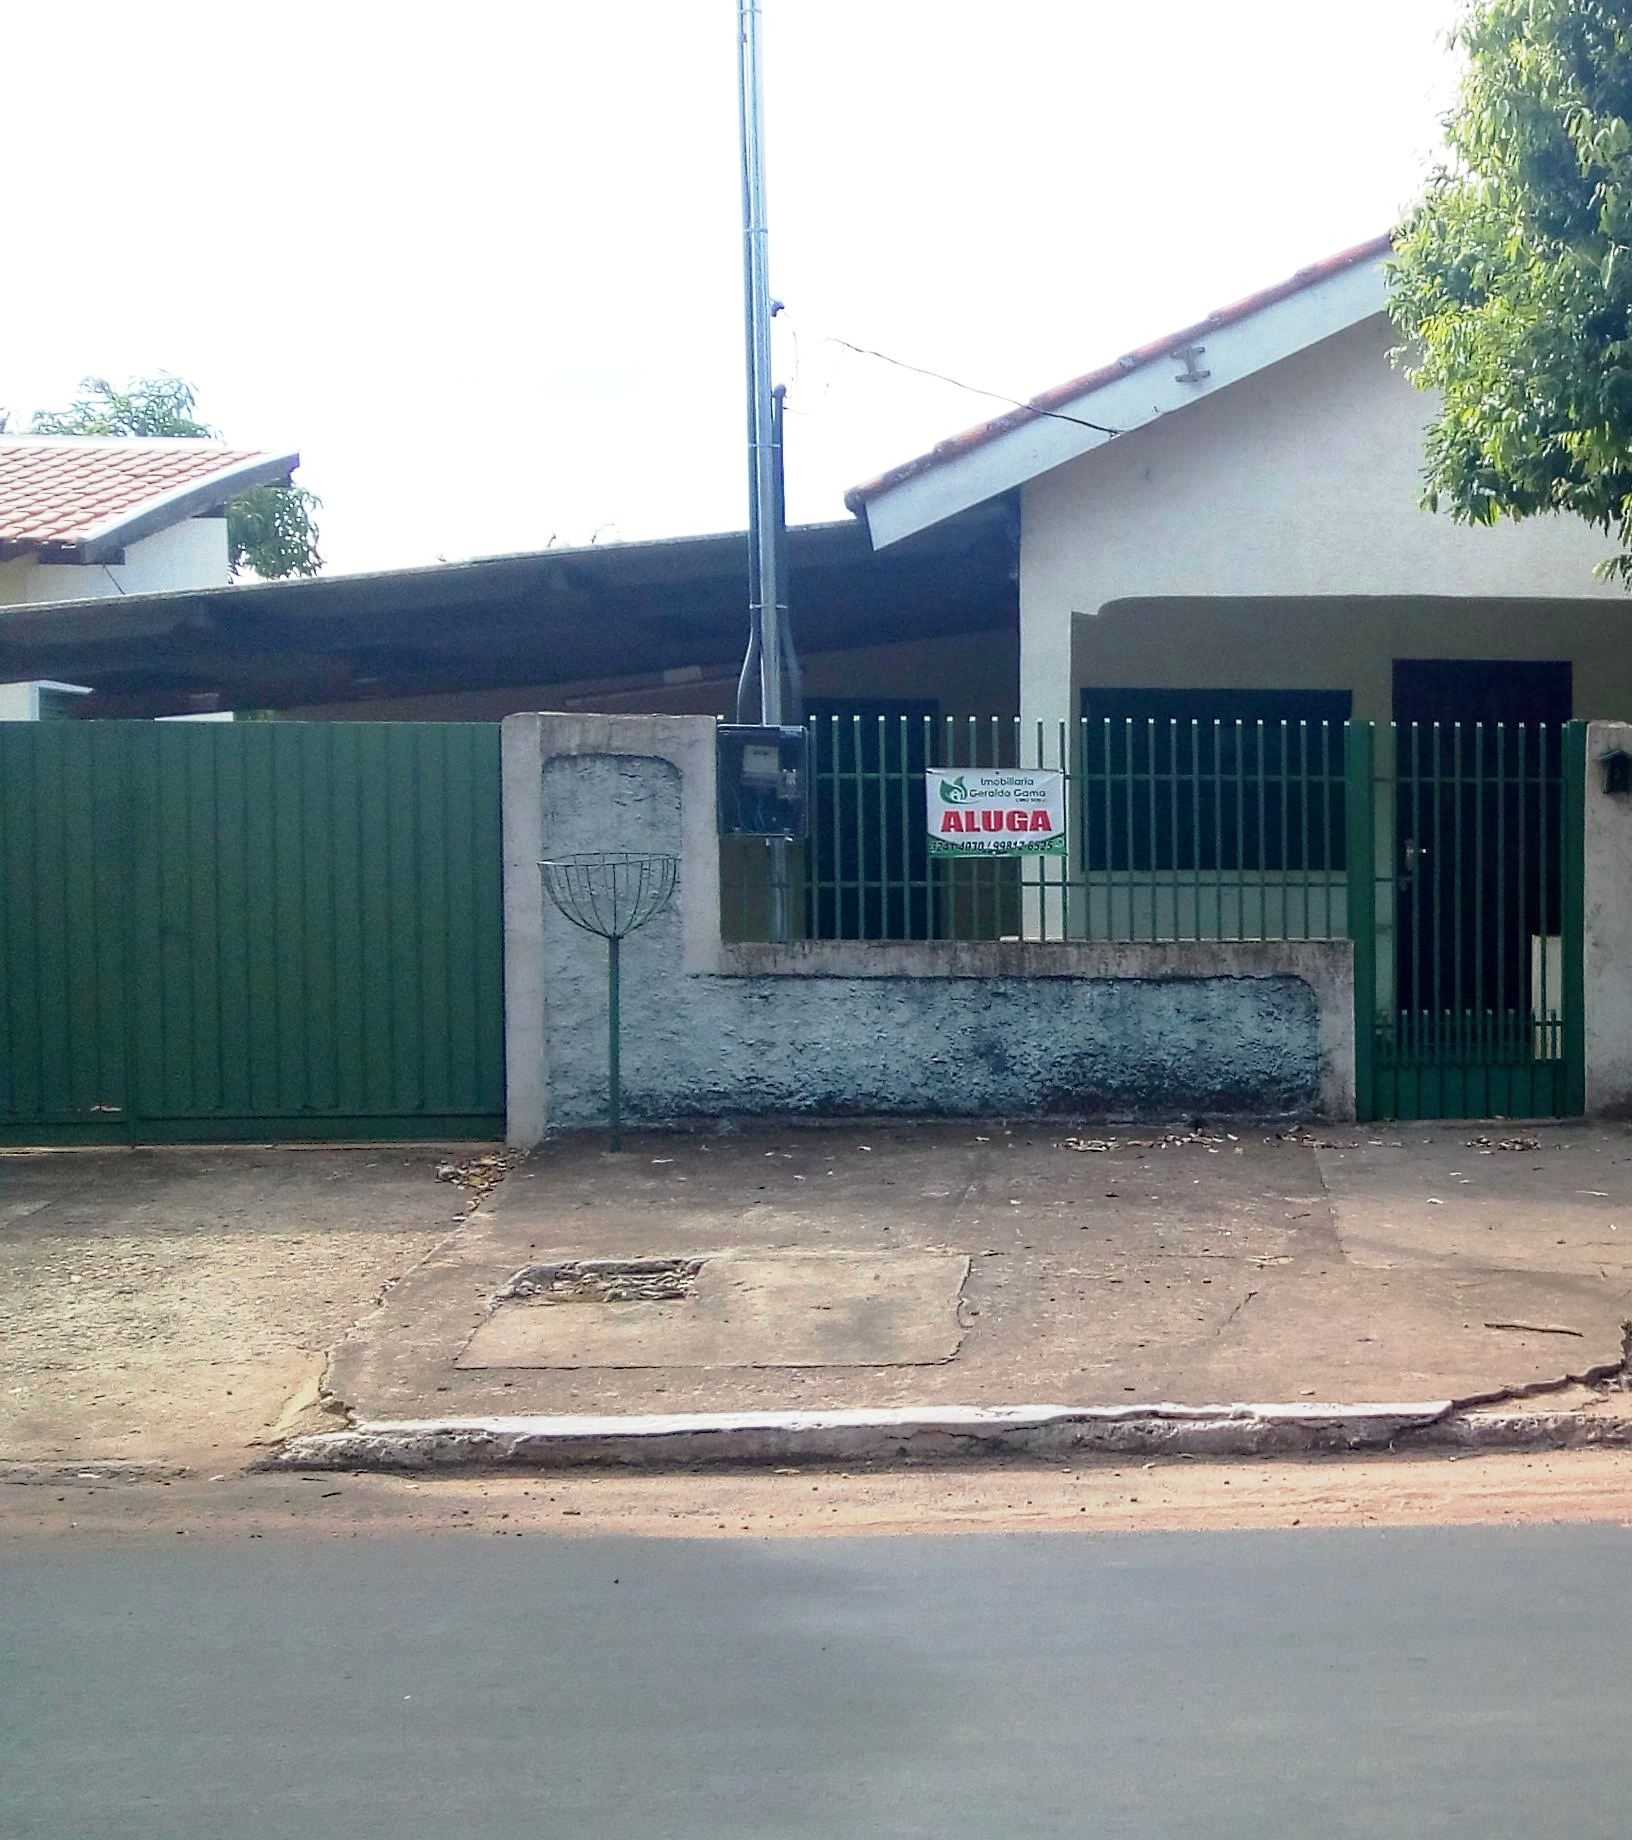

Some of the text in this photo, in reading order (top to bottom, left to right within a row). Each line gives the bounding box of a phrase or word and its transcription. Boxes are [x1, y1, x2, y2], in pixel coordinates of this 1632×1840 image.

[969, 788, 1047, 798] Geraldo Gama
[940, 810, 1052, 832] ALUGA
